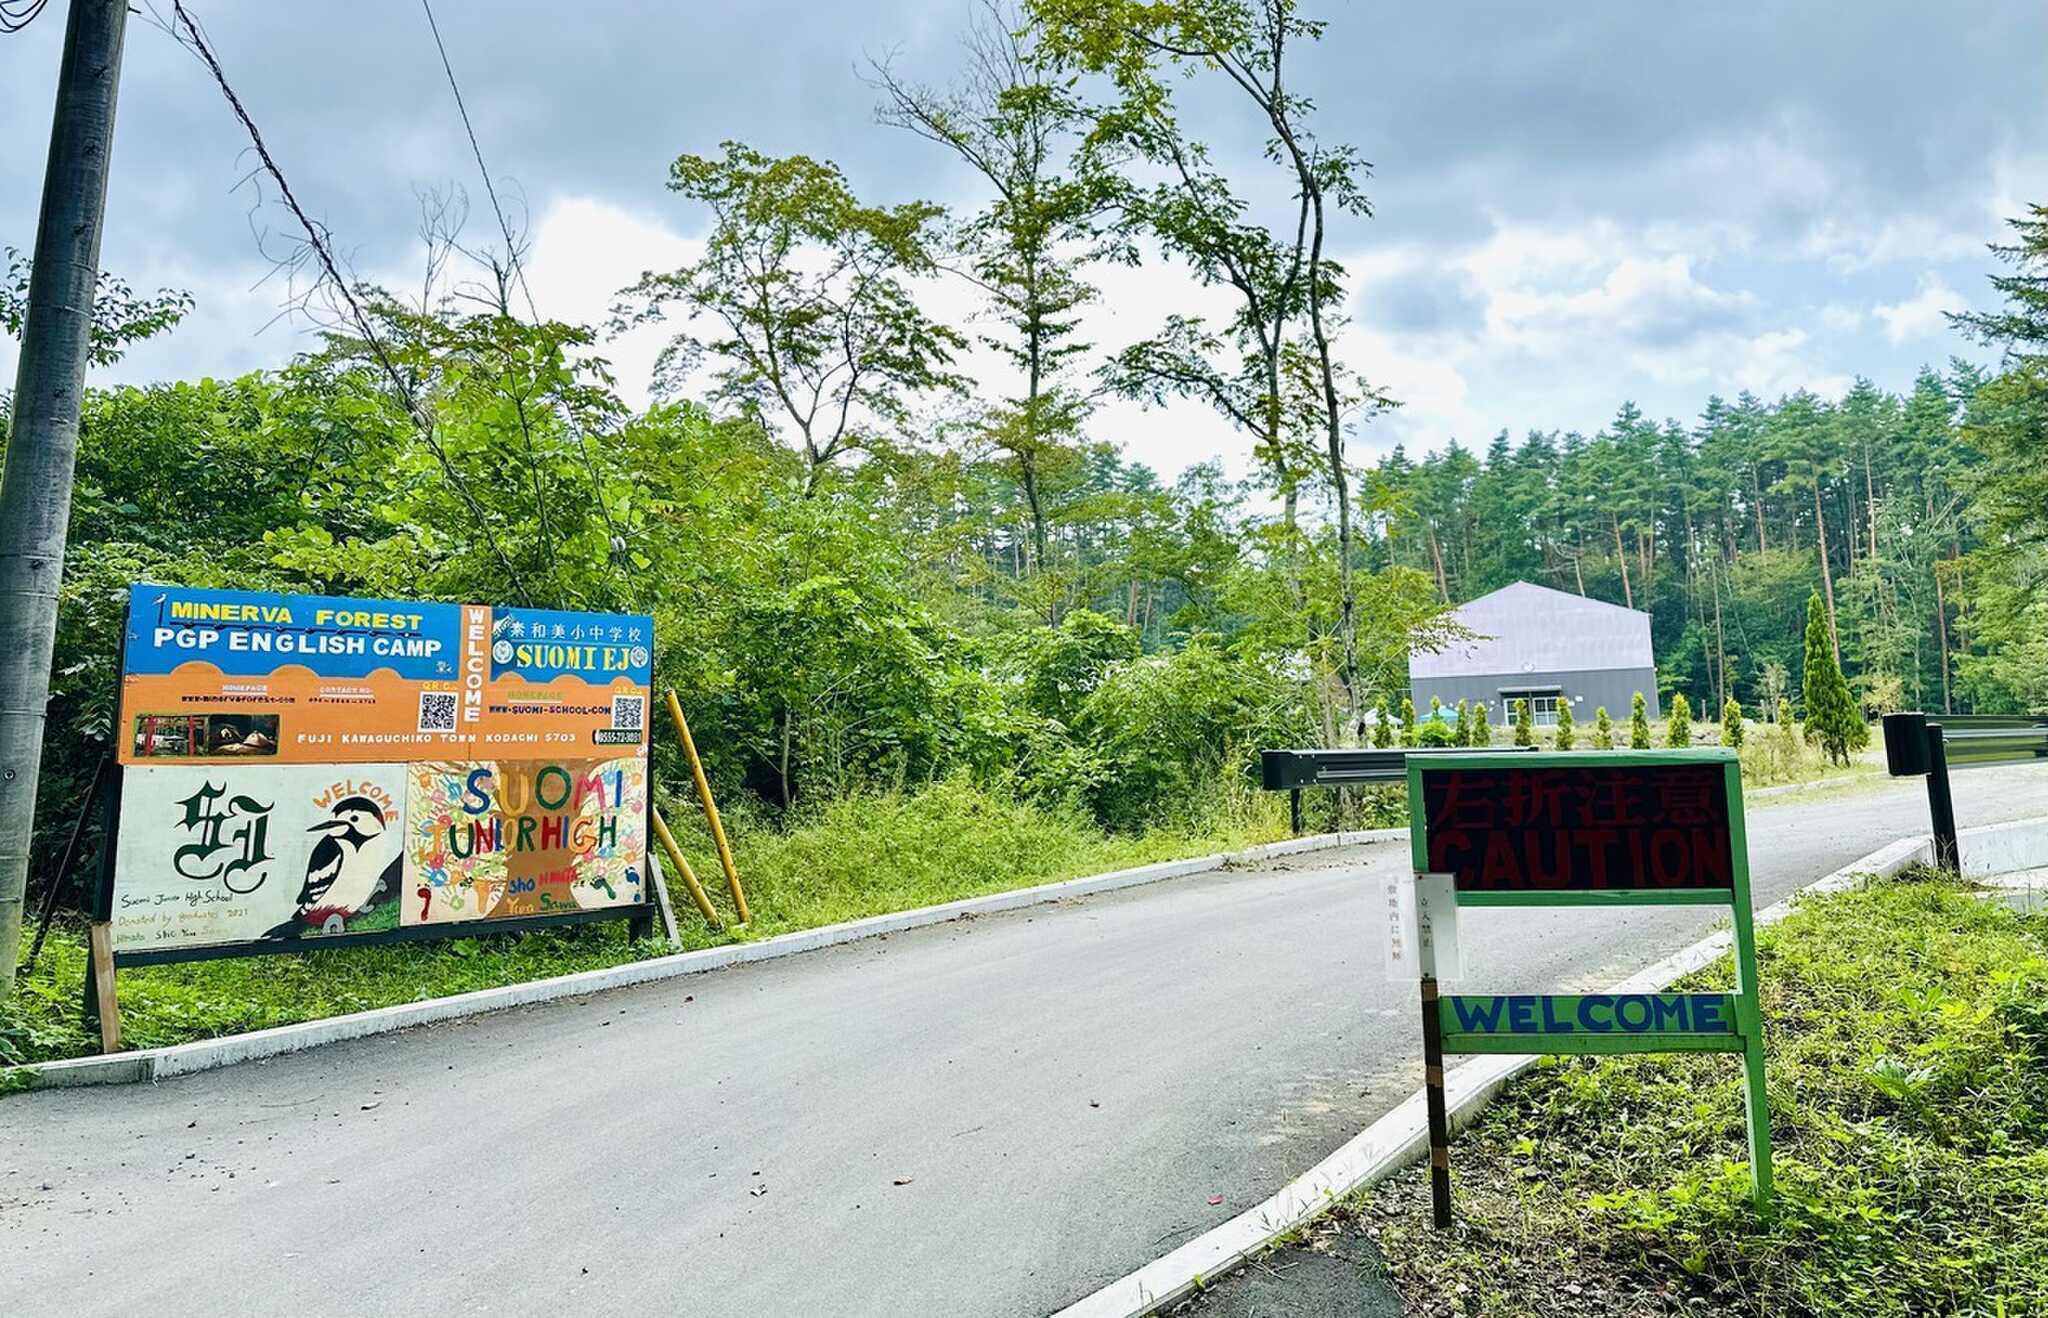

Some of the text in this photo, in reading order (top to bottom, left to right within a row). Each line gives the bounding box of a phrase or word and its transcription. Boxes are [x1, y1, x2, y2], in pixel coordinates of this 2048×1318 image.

[171, 601, 424, 631] MINERVA FOREST
[153, 628, 443, 659] PGP ENGLISH CAMP
[516, 644, 632, 671] SUOMI EJ
[464, 608, 485, 722] WELCOME
[297, 732, 576, 744] FUJI KAWAGUCHIKO TOWN KODACHI 5703
[312, 778, 399, 823] WELCOME
[463, 765, 624, 818] SUOMI
[1431, 769, 1715, 829] 右折注意
[1431, 830, 1732, 890] CAUTION
[185, 891, 203, 907] High
[203, 890, 233, 904] School
[1452, 995, 1729, 1034] WELCOME
